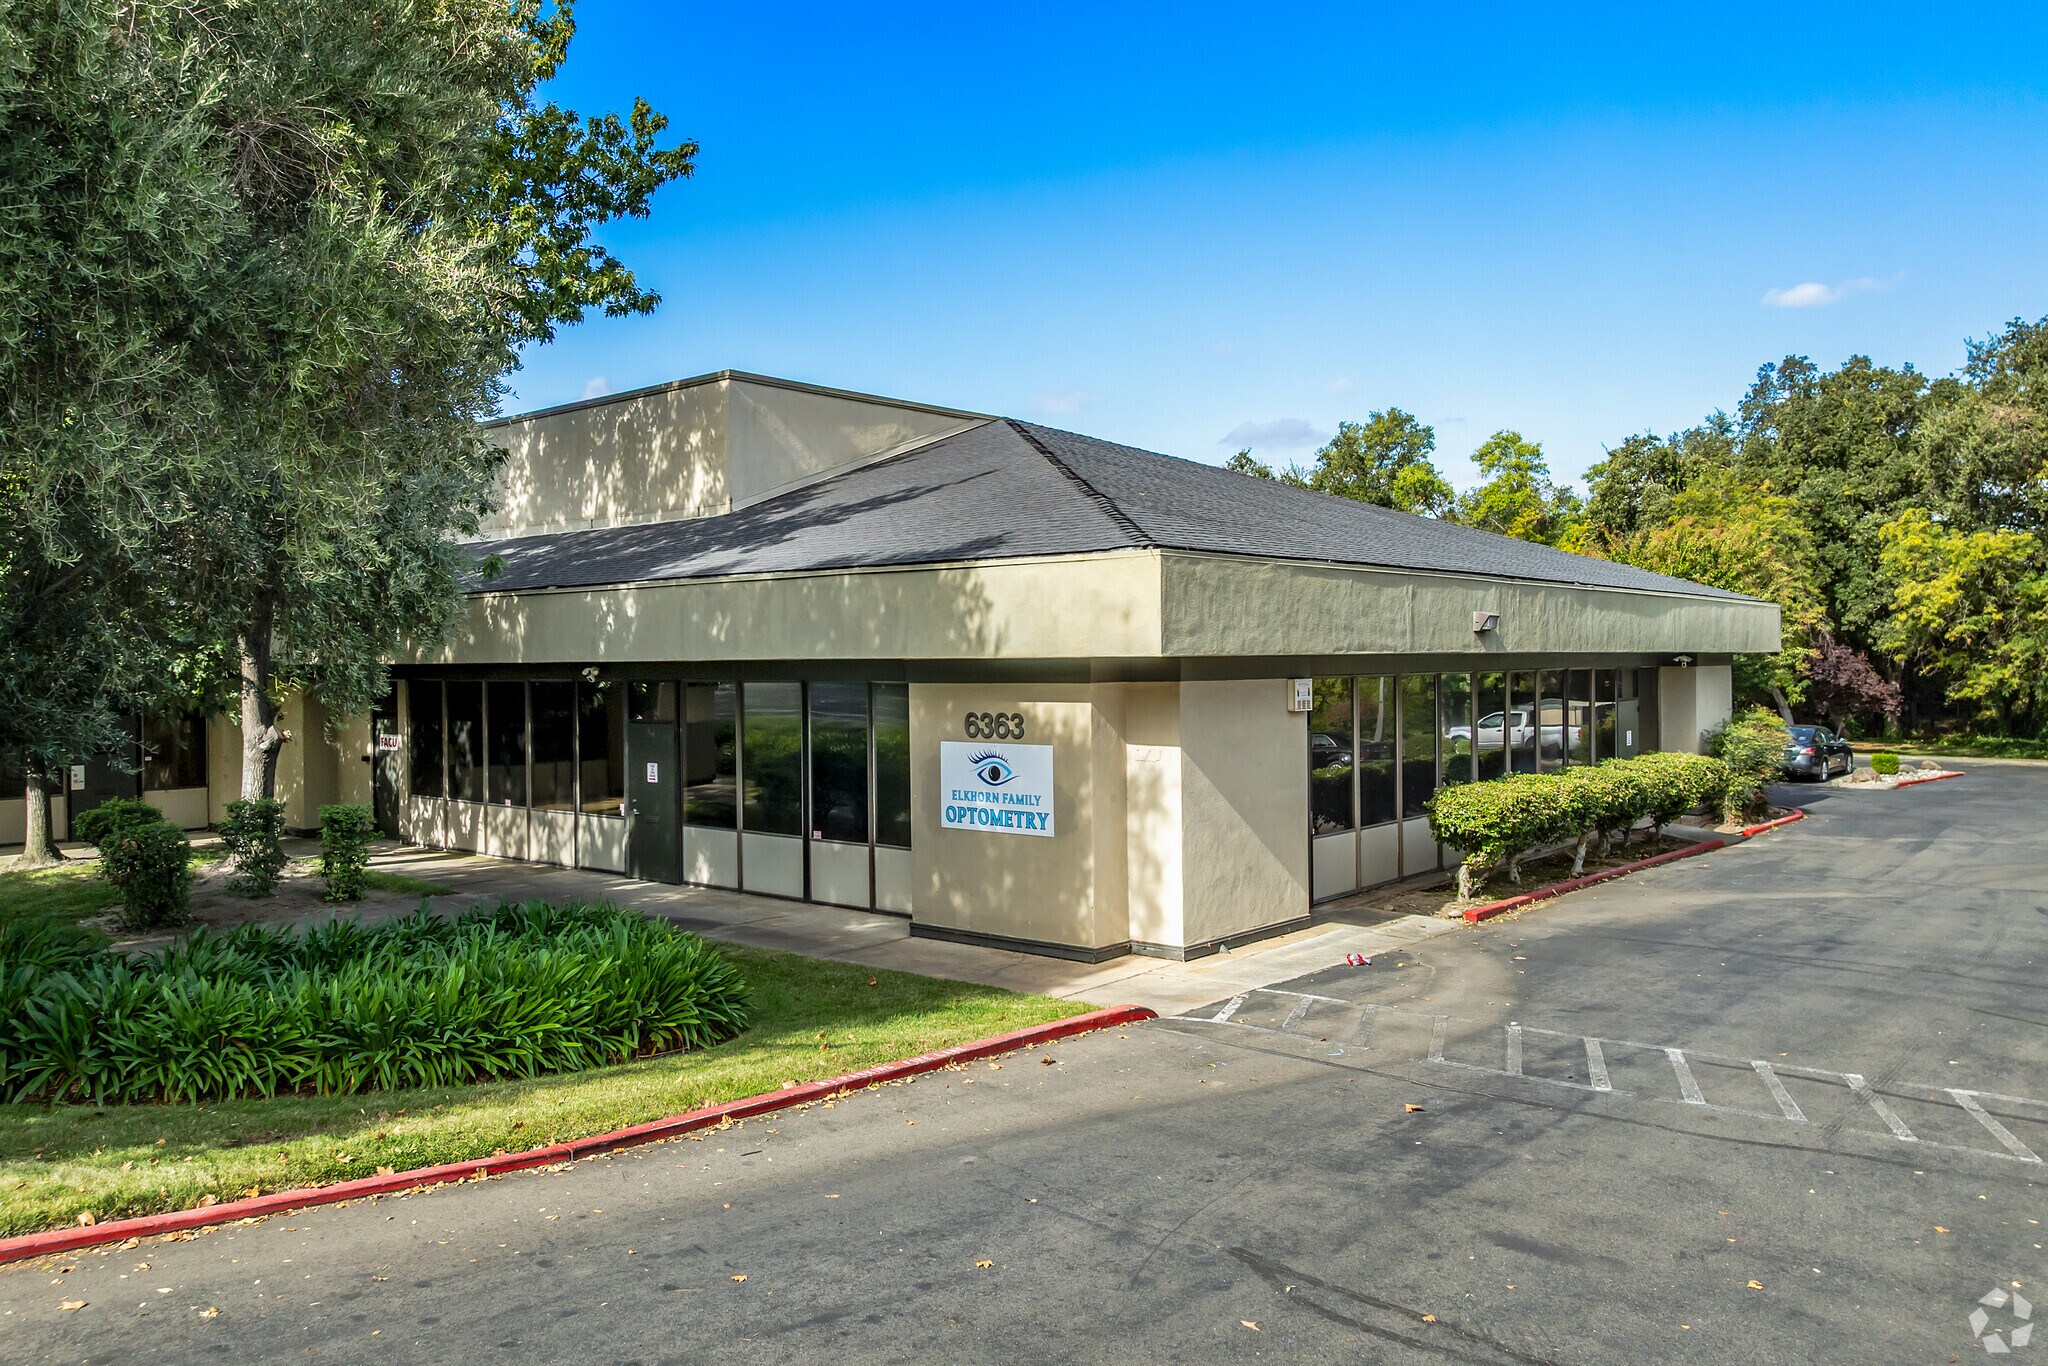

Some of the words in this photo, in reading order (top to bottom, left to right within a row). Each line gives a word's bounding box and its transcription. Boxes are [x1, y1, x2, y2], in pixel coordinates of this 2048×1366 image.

[964, 712, 1025, 739] 6363
[952, 789, 1000, 803] ELKHORN
[1002, 793, 1042, 806] FAMILY
[945, 805, 1049, 830] OPTOMETRY
